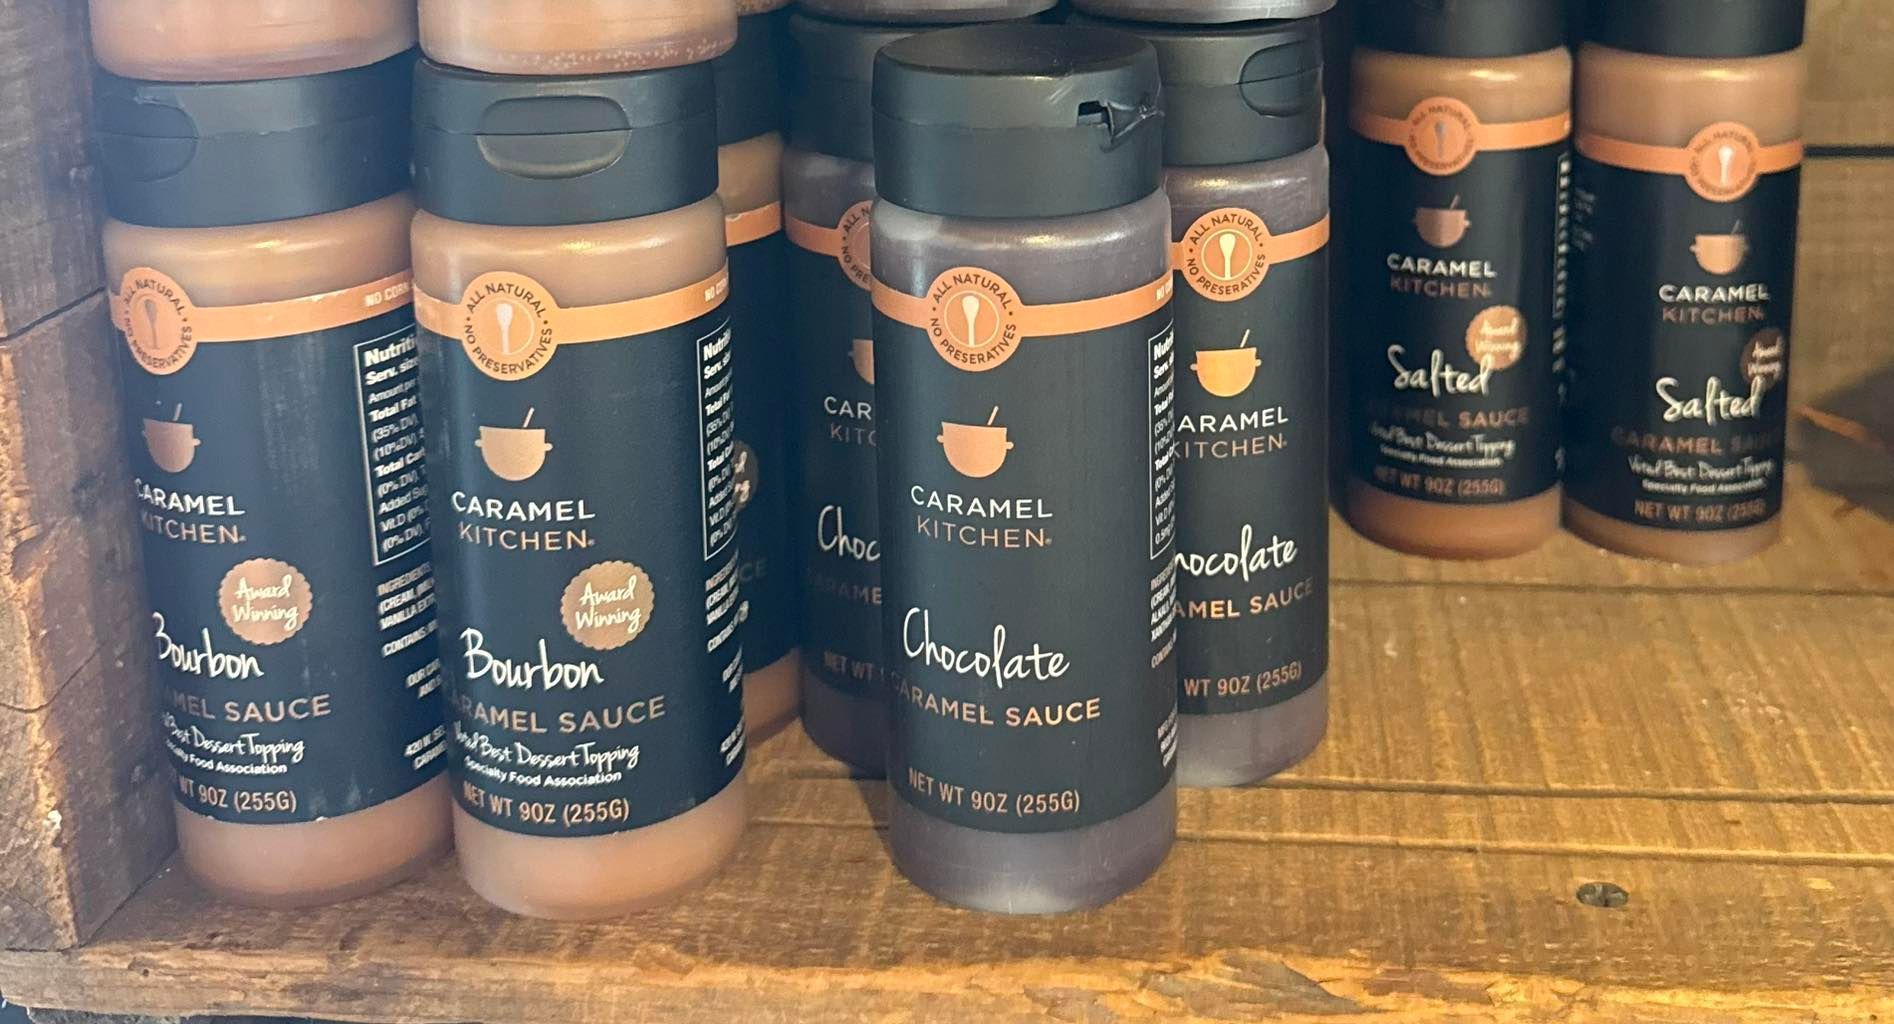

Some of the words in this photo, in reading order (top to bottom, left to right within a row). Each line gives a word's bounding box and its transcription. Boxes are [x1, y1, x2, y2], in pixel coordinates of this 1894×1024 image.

[843, 213, 860, 236] ALL
[1191, 224, 1211, 245] ALL
[1211, 212, 1262, 242] NATURAL
[840, 246, 852, 265] NO
[1386, 252, 1497, 279] CARAMEL
[933, 282, 953, 304] ALL
[952, 273, 1010, 310] NATURAL
[1186, 257, 1199, 275] NO
[1197, 253, 1266, 296] PRESERATIVES
[135, 277, 184, 317] NATURAL
[466, 289, 487, 315] ALL
[485, 282, 544, 319] NATURAL
[1658, 283, 1770, 303] CARAMEL
[464, 323, 476, 346] NO
[473, 326, 554, 376] PRESERVATIVES
[930, 317, 942, 338] NO
[940, 323, 1017, 365] PRESERATIVES
[365, 366, 398, 386] Serv.
[1387, 344, 1496, 398] Salted
[369, 403, 400, 423] Total
[1458, 406, 1529, 429] SAUCE
[1655, 376, 1766, 426] Salted
[374, 458, 404, 478] Total
[135, 478, 246, 516] CARAMEL
[452, 491, 597, 522] CARAMEL
[910, 484, 1053, 519] CARAMEL
[459, 520, 588, 552] KITCHEN
[916, 515, 1046, 549] KITCHEN
[235, 574, 292, 600] Award
[578, 574, 638, 608] Award
[1250, 577, 1314, 614] SAUCE
[232, 604, 299, 631] Winning
[575, 606, 642, 634] Winning
[151, 611, 265, 679] Bourbon
[459, 626, 605, 691] Bourbon
[902, 606, 1071, 689] Chocolate
[1184, 679, 1211, 697] WT
[1256, 661, 1303, 693] (255G)
[224, 693, 332, 723] SAUCE
[558, 694, 667, 735] SAUCE
[1005, 696, 1101, 727] SAUCE
[191, 725, 247, 756] Dessert
[241, 732, 305, 764] Topping
[479, 733, 512, 763] Best
[514, 741, 579, 768] Dessert
[574, 740, 641, 772] Topping
[189, 753, 214, 771] Food
[215, 760, 288, 775] Association
[464, 756, 507, 783] Specialty
[509, 770, 541, 788] Food
[543, 770, 622, 788] Association
[178, 776, 194, 799] WT
[198, 784, 229, 808] 9OZ
[233, 790, 297, 814] (255G)
[462, 781, 486, 808] NET
[489, 793, 513, 817] WT
[519, 800, 556, 824] 9OZ
[562, 797, 630, 828] (255G)
[907, 767, 934, 796] NET
[938, 781, 965, 806] WT
[971, 790, 1009, 814] 9OZ
[1016, 789, 1081, 818] (255G)
